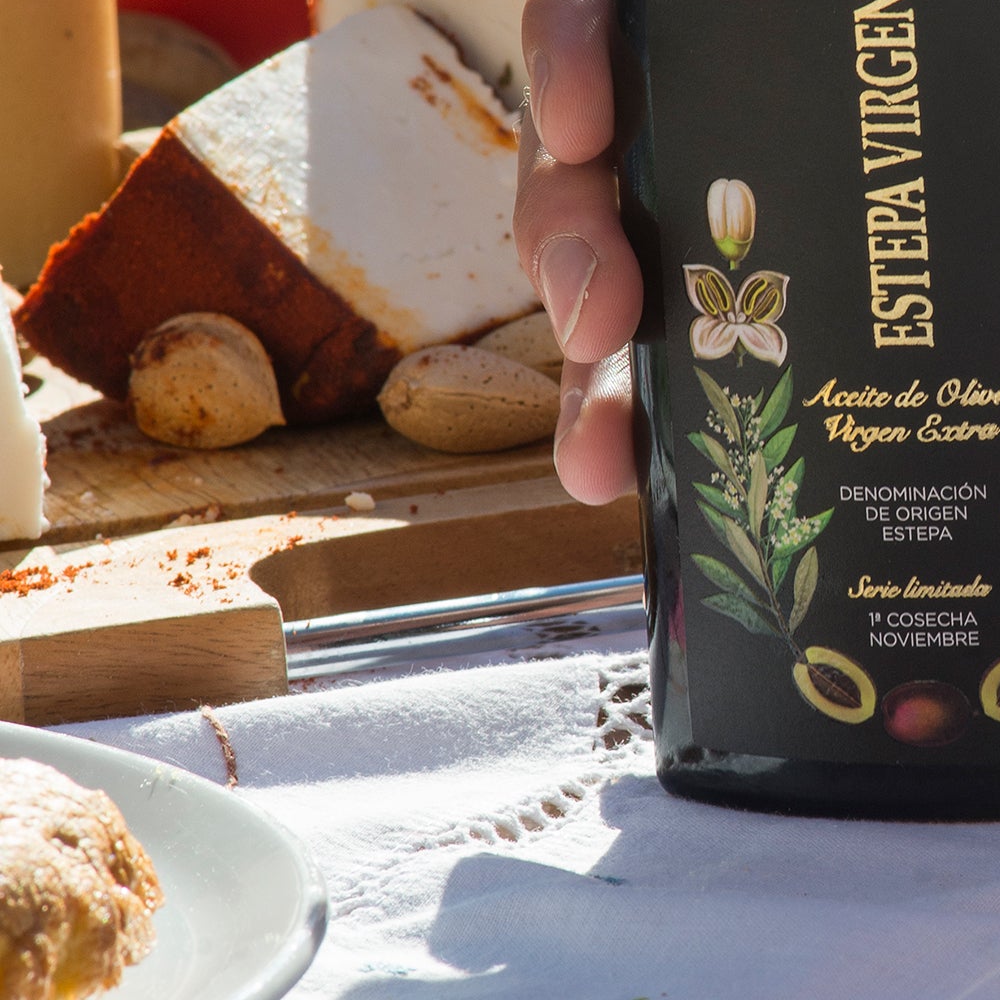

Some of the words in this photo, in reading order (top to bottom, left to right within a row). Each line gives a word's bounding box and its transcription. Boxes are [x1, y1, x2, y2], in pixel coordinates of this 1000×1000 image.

[865, 176, 935, 349] ESTEPA
[802, 377, 893, 408] Aceite
[894, 379, 929, 408] de
[824, 413, 911, 452] Virgen
[840, 482, 987, 501] DENOMINACIÓN
[865, 506, 890, 521] DE
[896, 506, 968, 521] ORIGEN
[882, 526, 953, 541] ESTEPA
[848, 575, 902, 598] Serie
[903, 574, 993, 598] limitada
[868, 612, 882, 627] 1ª
[887, 612, 978, 627] COSECHA
[870, 631, 980, 647] NOVIEMBRE
